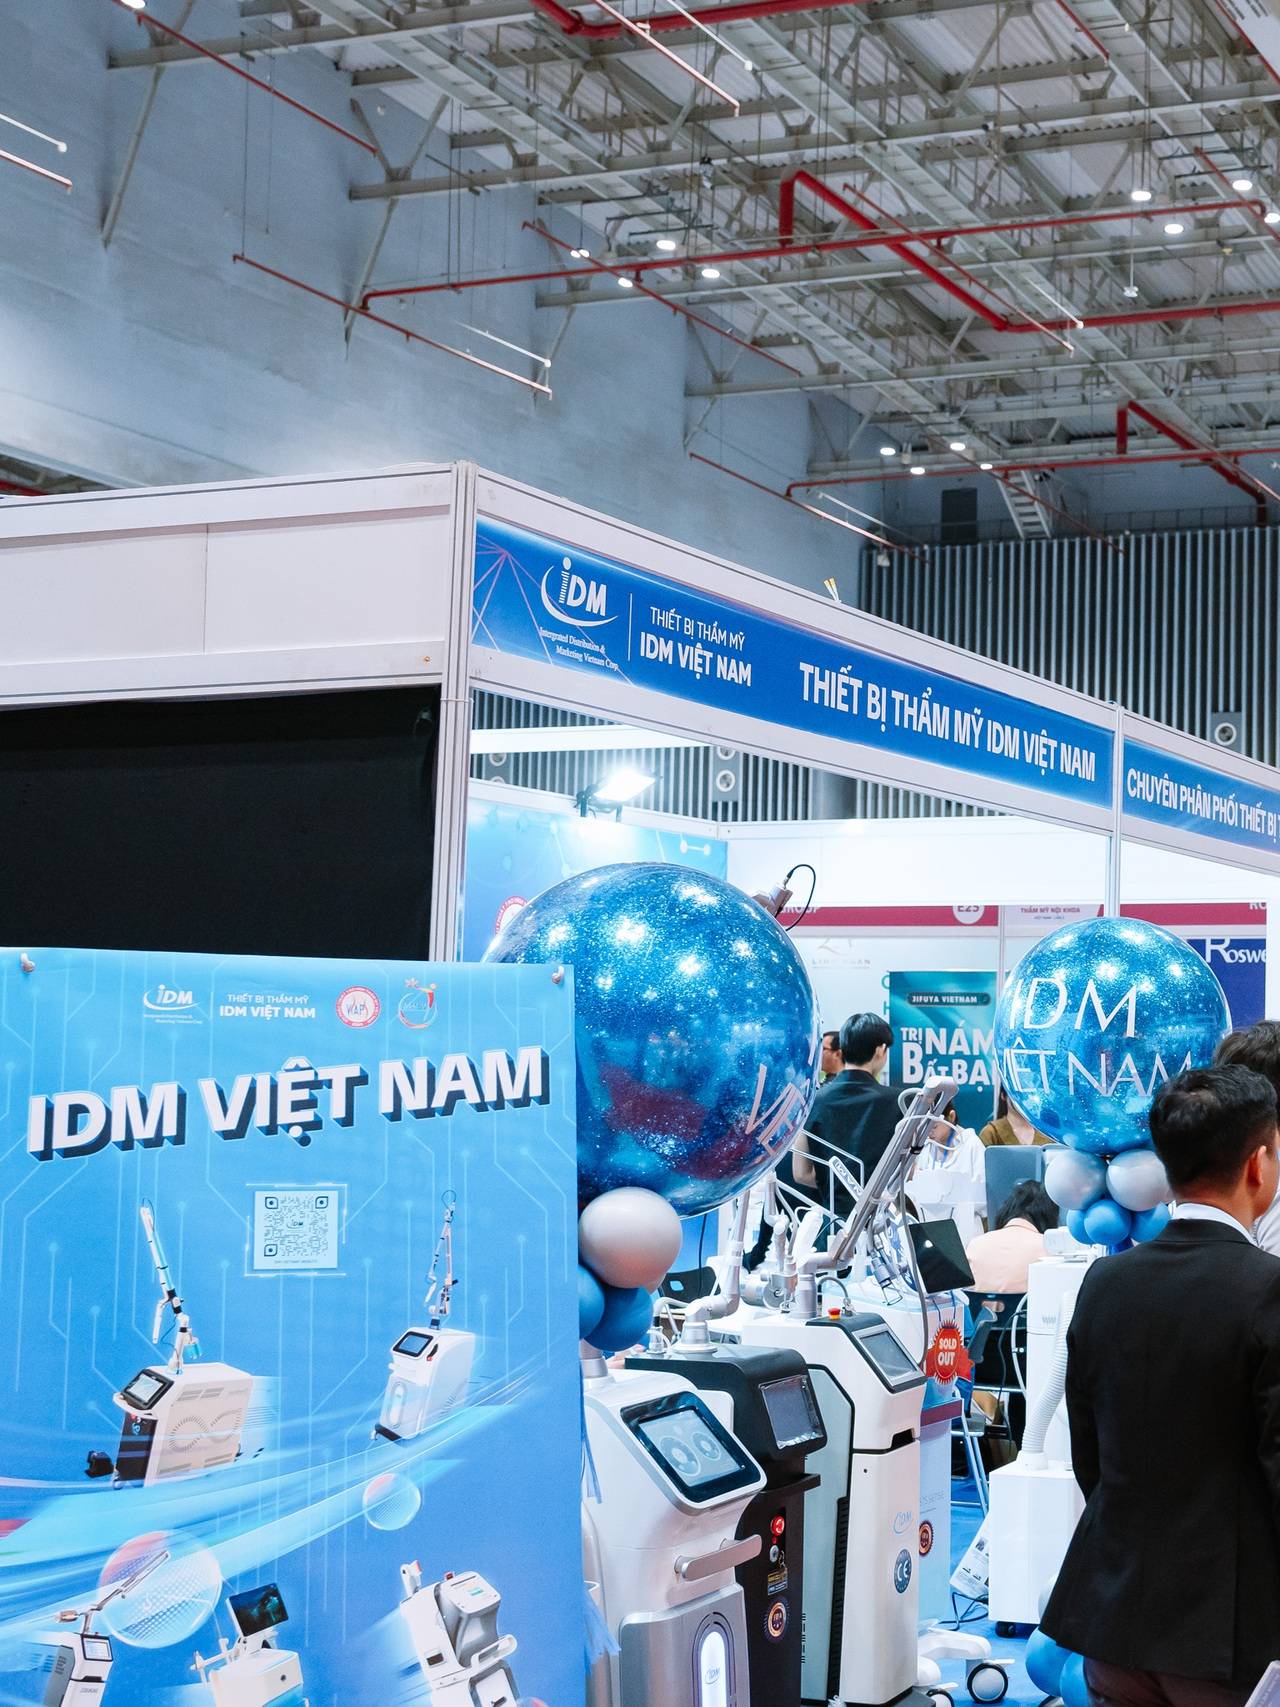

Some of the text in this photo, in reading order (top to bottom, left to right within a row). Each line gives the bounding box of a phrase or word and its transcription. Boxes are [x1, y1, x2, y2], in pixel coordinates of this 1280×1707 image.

[650, 606, 681, 632] THIẾT
[683, 615, 695, 640] BỊ
[729, 631, 746, 652] MỸ
[640, 632, 752, 687] IDM VIỆT NAM
[800, 661, 1096, 782] THIẾT BỊ THẨM MỸ IDM VIỆT NAM
[1127, 768, 1178, 810] CHUYÊN
[1180, 784, 1211, 820] PHÂN
[1212, 793, 1238, 826] PHỐI
[1239, 801, 1267, 834] THIẾT
[1267, 812, 1277, 844] BỊ
[219, 1004, 316, 1021] IDM VIỆT NAM
[227, 992, 254, 1003] THIẾT
[912, 995, 977, 1003] JIFUYA VIETNAM
[1009, 978, 1138, 1038] IDM
[900, 1027, 922, 1044] TRỊ
[27, 1047, 550, 1161] IDM VIỆT NAM
[938, 1352, 956, 1366] OUT
[939, 1338, 957, 1350] SOLD
